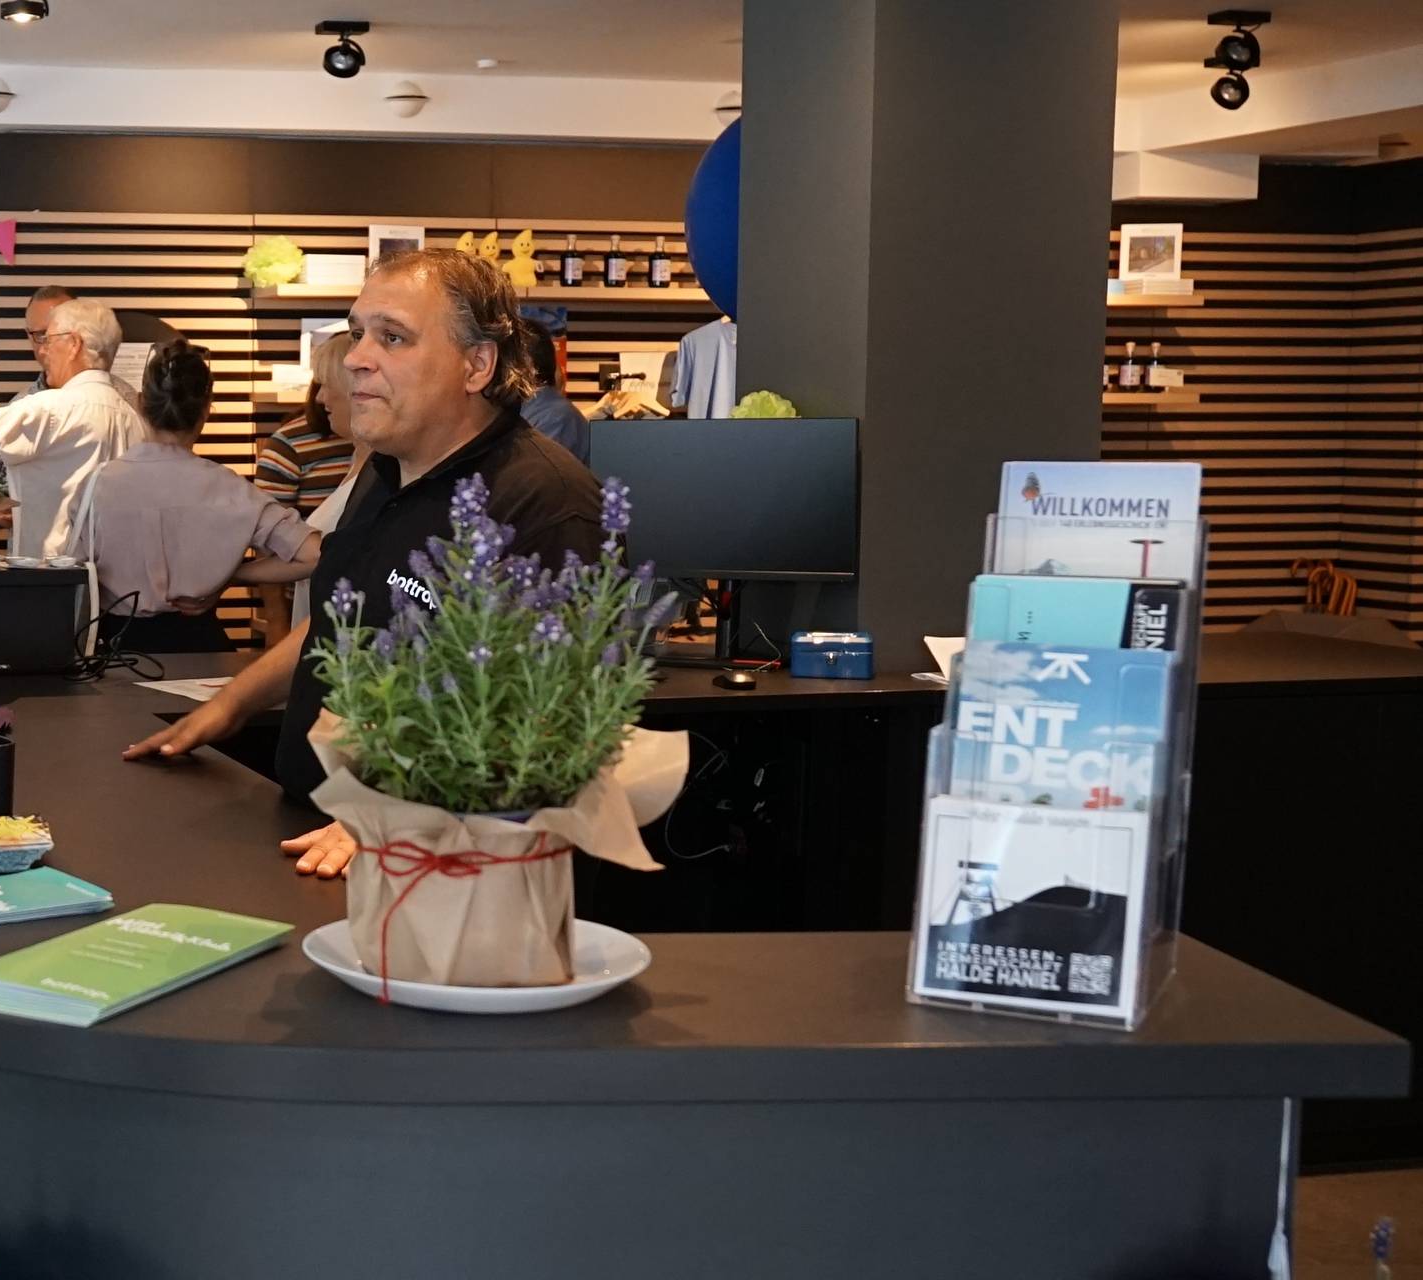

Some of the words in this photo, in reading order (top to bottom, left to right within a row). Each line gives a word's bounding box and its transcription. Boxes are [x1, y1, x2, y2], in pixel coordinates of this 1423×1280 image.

[1030, 497, 1170, 519] WILLKOMMEN
[956, 699, 1079, 748] ENT
[988, 743, 1152, 800] DECK
[936, 950, 1063, 974] GEMEINSCHAFT
[937, 940, 1064, 962] INTERESSEN-
[935, 961, 995, 985] HALDE
[996, 967, 1062, 992] HANIEL
